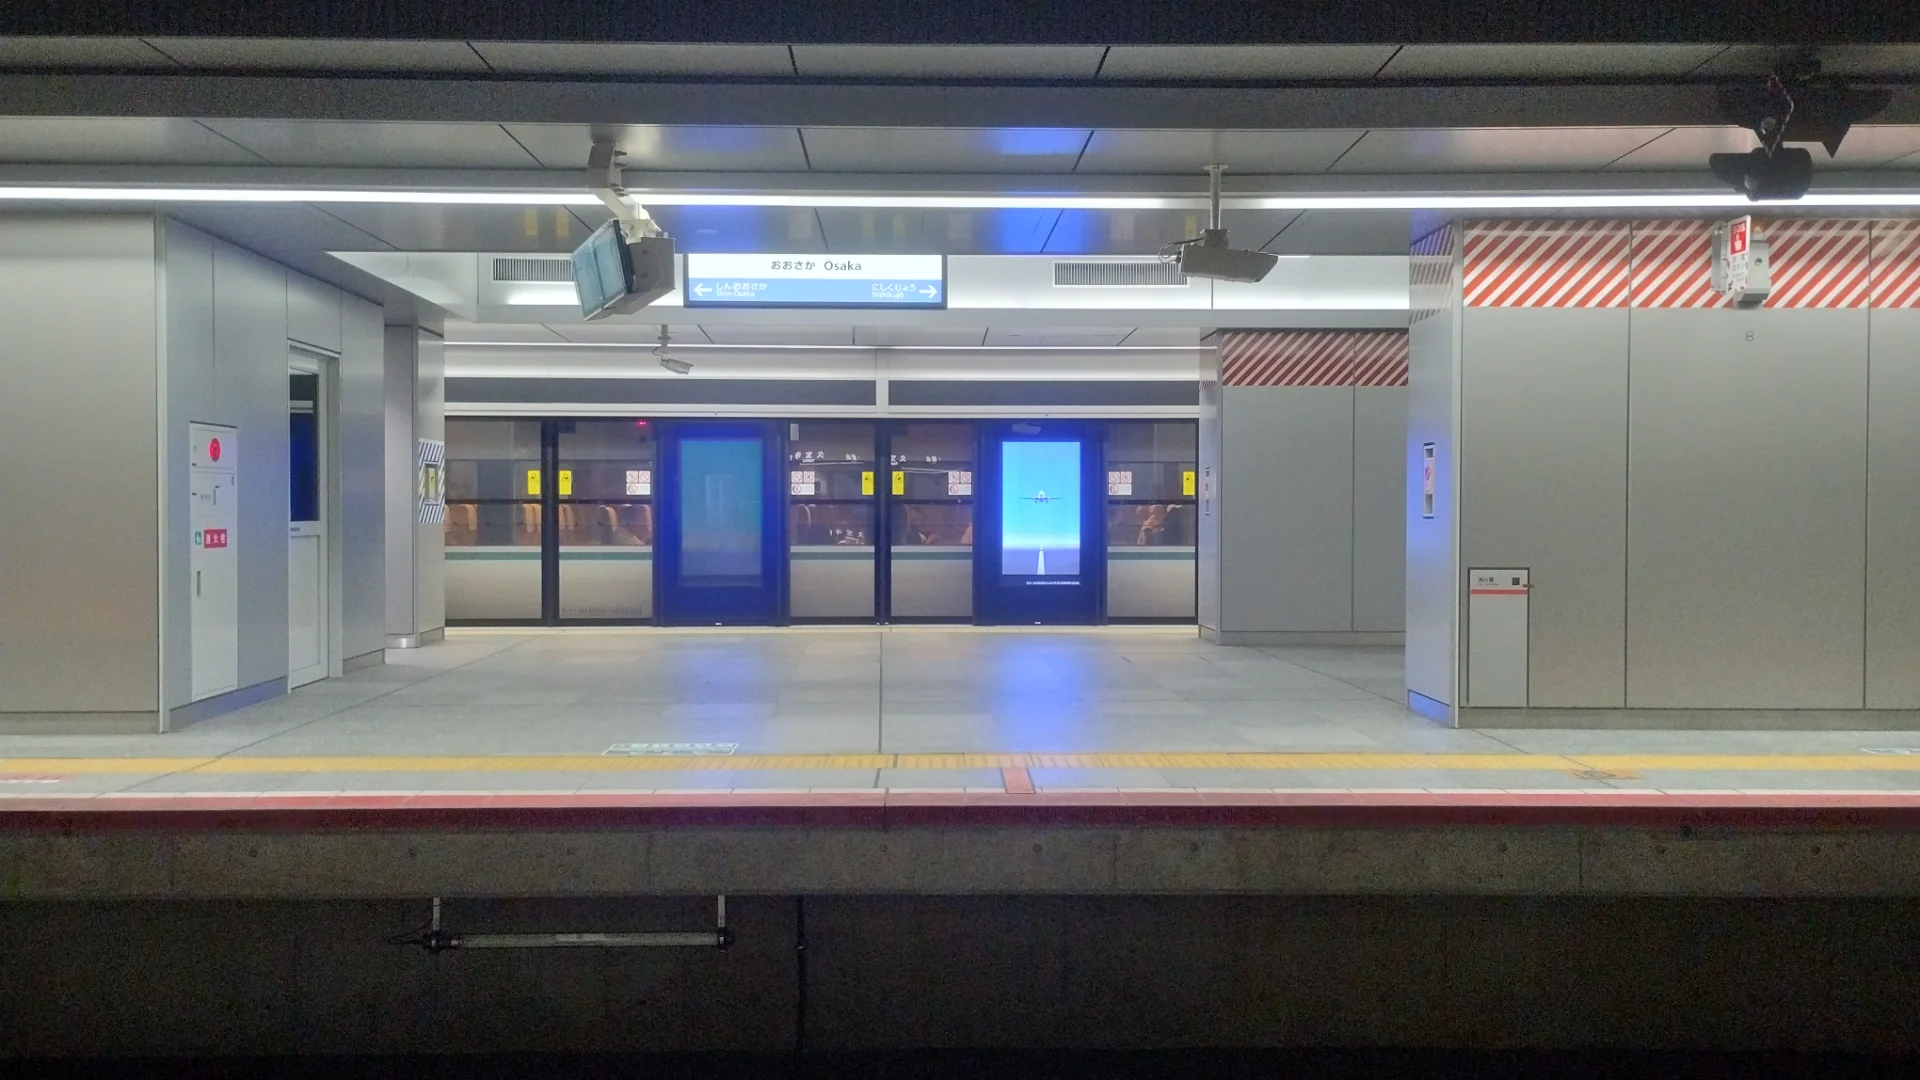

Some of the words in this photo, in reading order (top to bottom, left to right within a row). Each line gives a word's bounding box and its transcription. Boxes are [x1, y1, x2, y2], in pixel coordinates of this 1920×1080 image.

[1732, 222, 1746, 234] SOS
[771, 260, 816, 271] おおさか
[716, 282, 768, 291] しんおおさか
[872, 283, 916, 292] にしくじょう
[1745, 330, 1755, 343] 8
